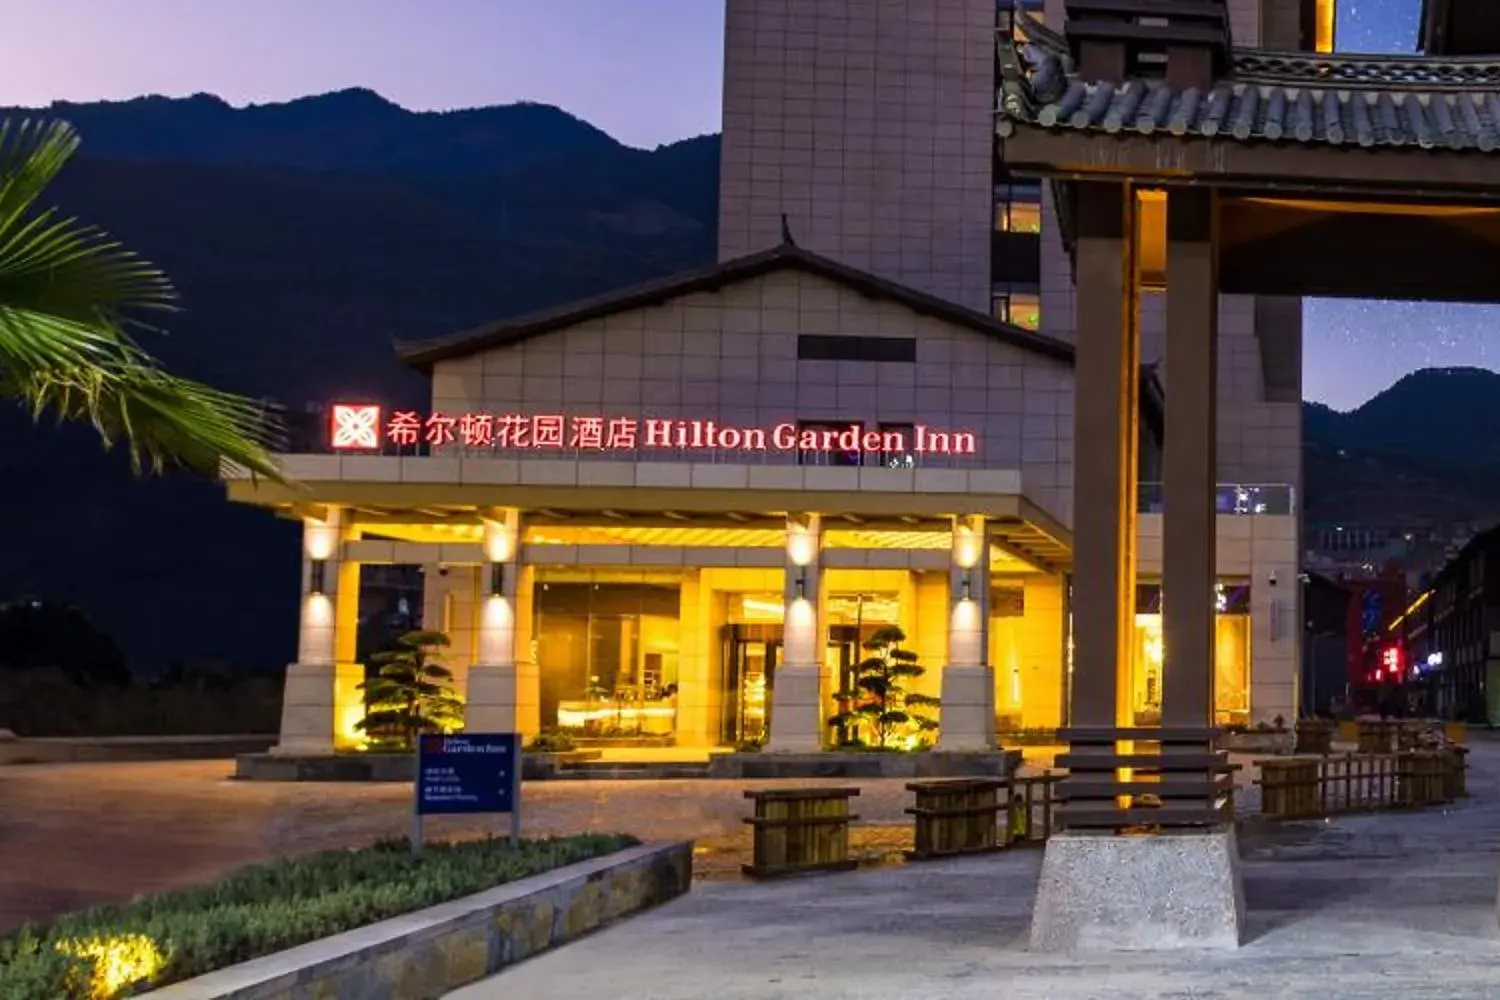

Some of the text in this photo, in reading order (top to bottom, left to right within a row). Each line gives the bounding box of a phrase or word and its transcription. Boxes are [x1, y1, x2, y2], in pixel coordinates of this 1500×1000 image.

[387, 410, 638, 449] 希尔顿花园酒店
[645, 419, 976, 454] Hilton Garden Inn
